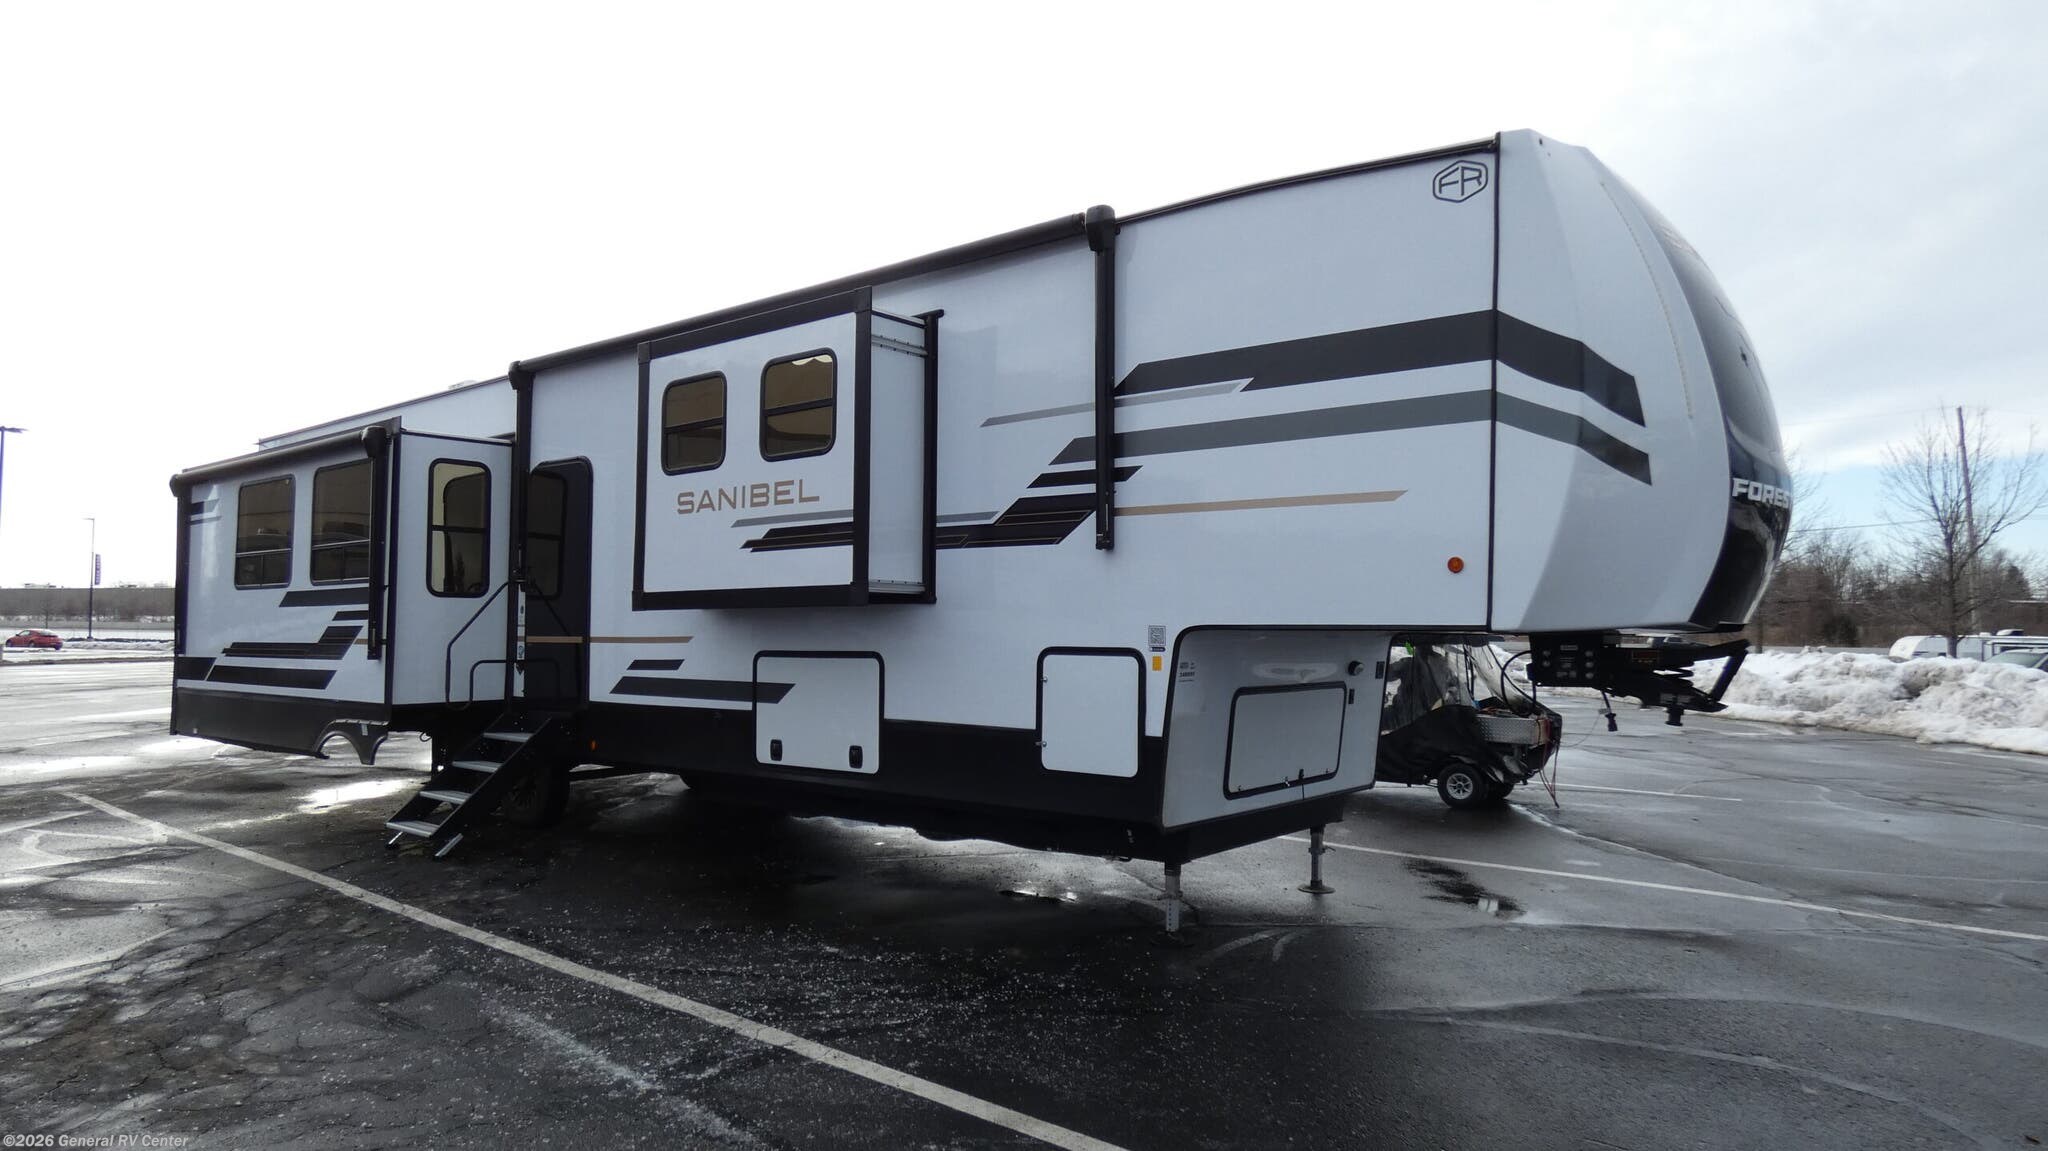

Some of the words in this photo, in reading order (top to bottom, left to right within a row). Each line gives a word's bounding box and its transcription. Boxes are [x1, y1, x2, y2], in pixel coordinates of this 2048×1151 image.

[1439, 166, 1482, 196] FR
[677, 479, 820, 514] SANIBEL
[1732, 477, 1792, 509] FORES
